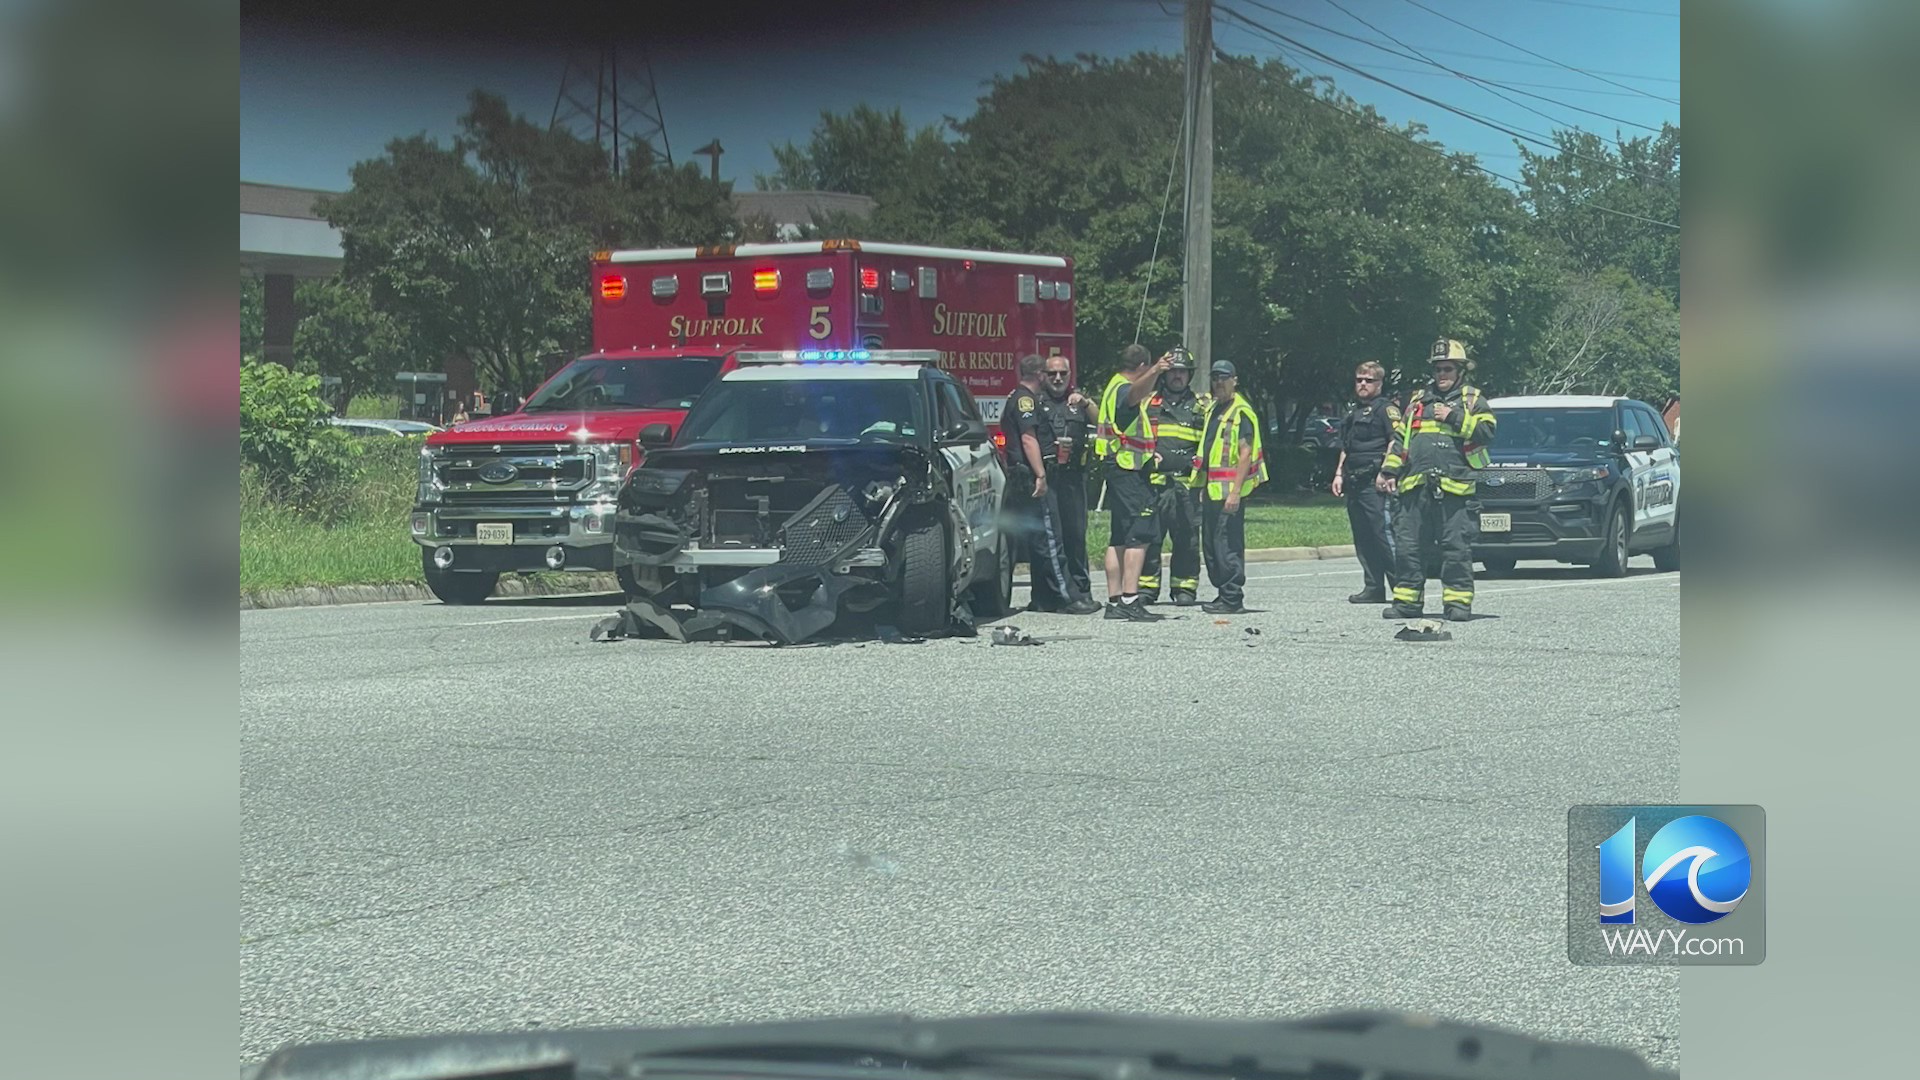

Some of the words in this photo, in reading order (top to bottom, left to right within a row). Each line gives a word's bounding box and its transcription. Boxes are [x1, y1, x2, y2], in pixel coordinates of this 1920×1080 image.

[669, 315, 764, 338] SUFFOLK
[809, 306, 832, 340] 5
[933, 303, 1008, 338] SUFFOLK
[958, 352, 967, 370] &
[969, 352, 1015, 371] RESCUE
[768, 445, 806, 453] POLICE
